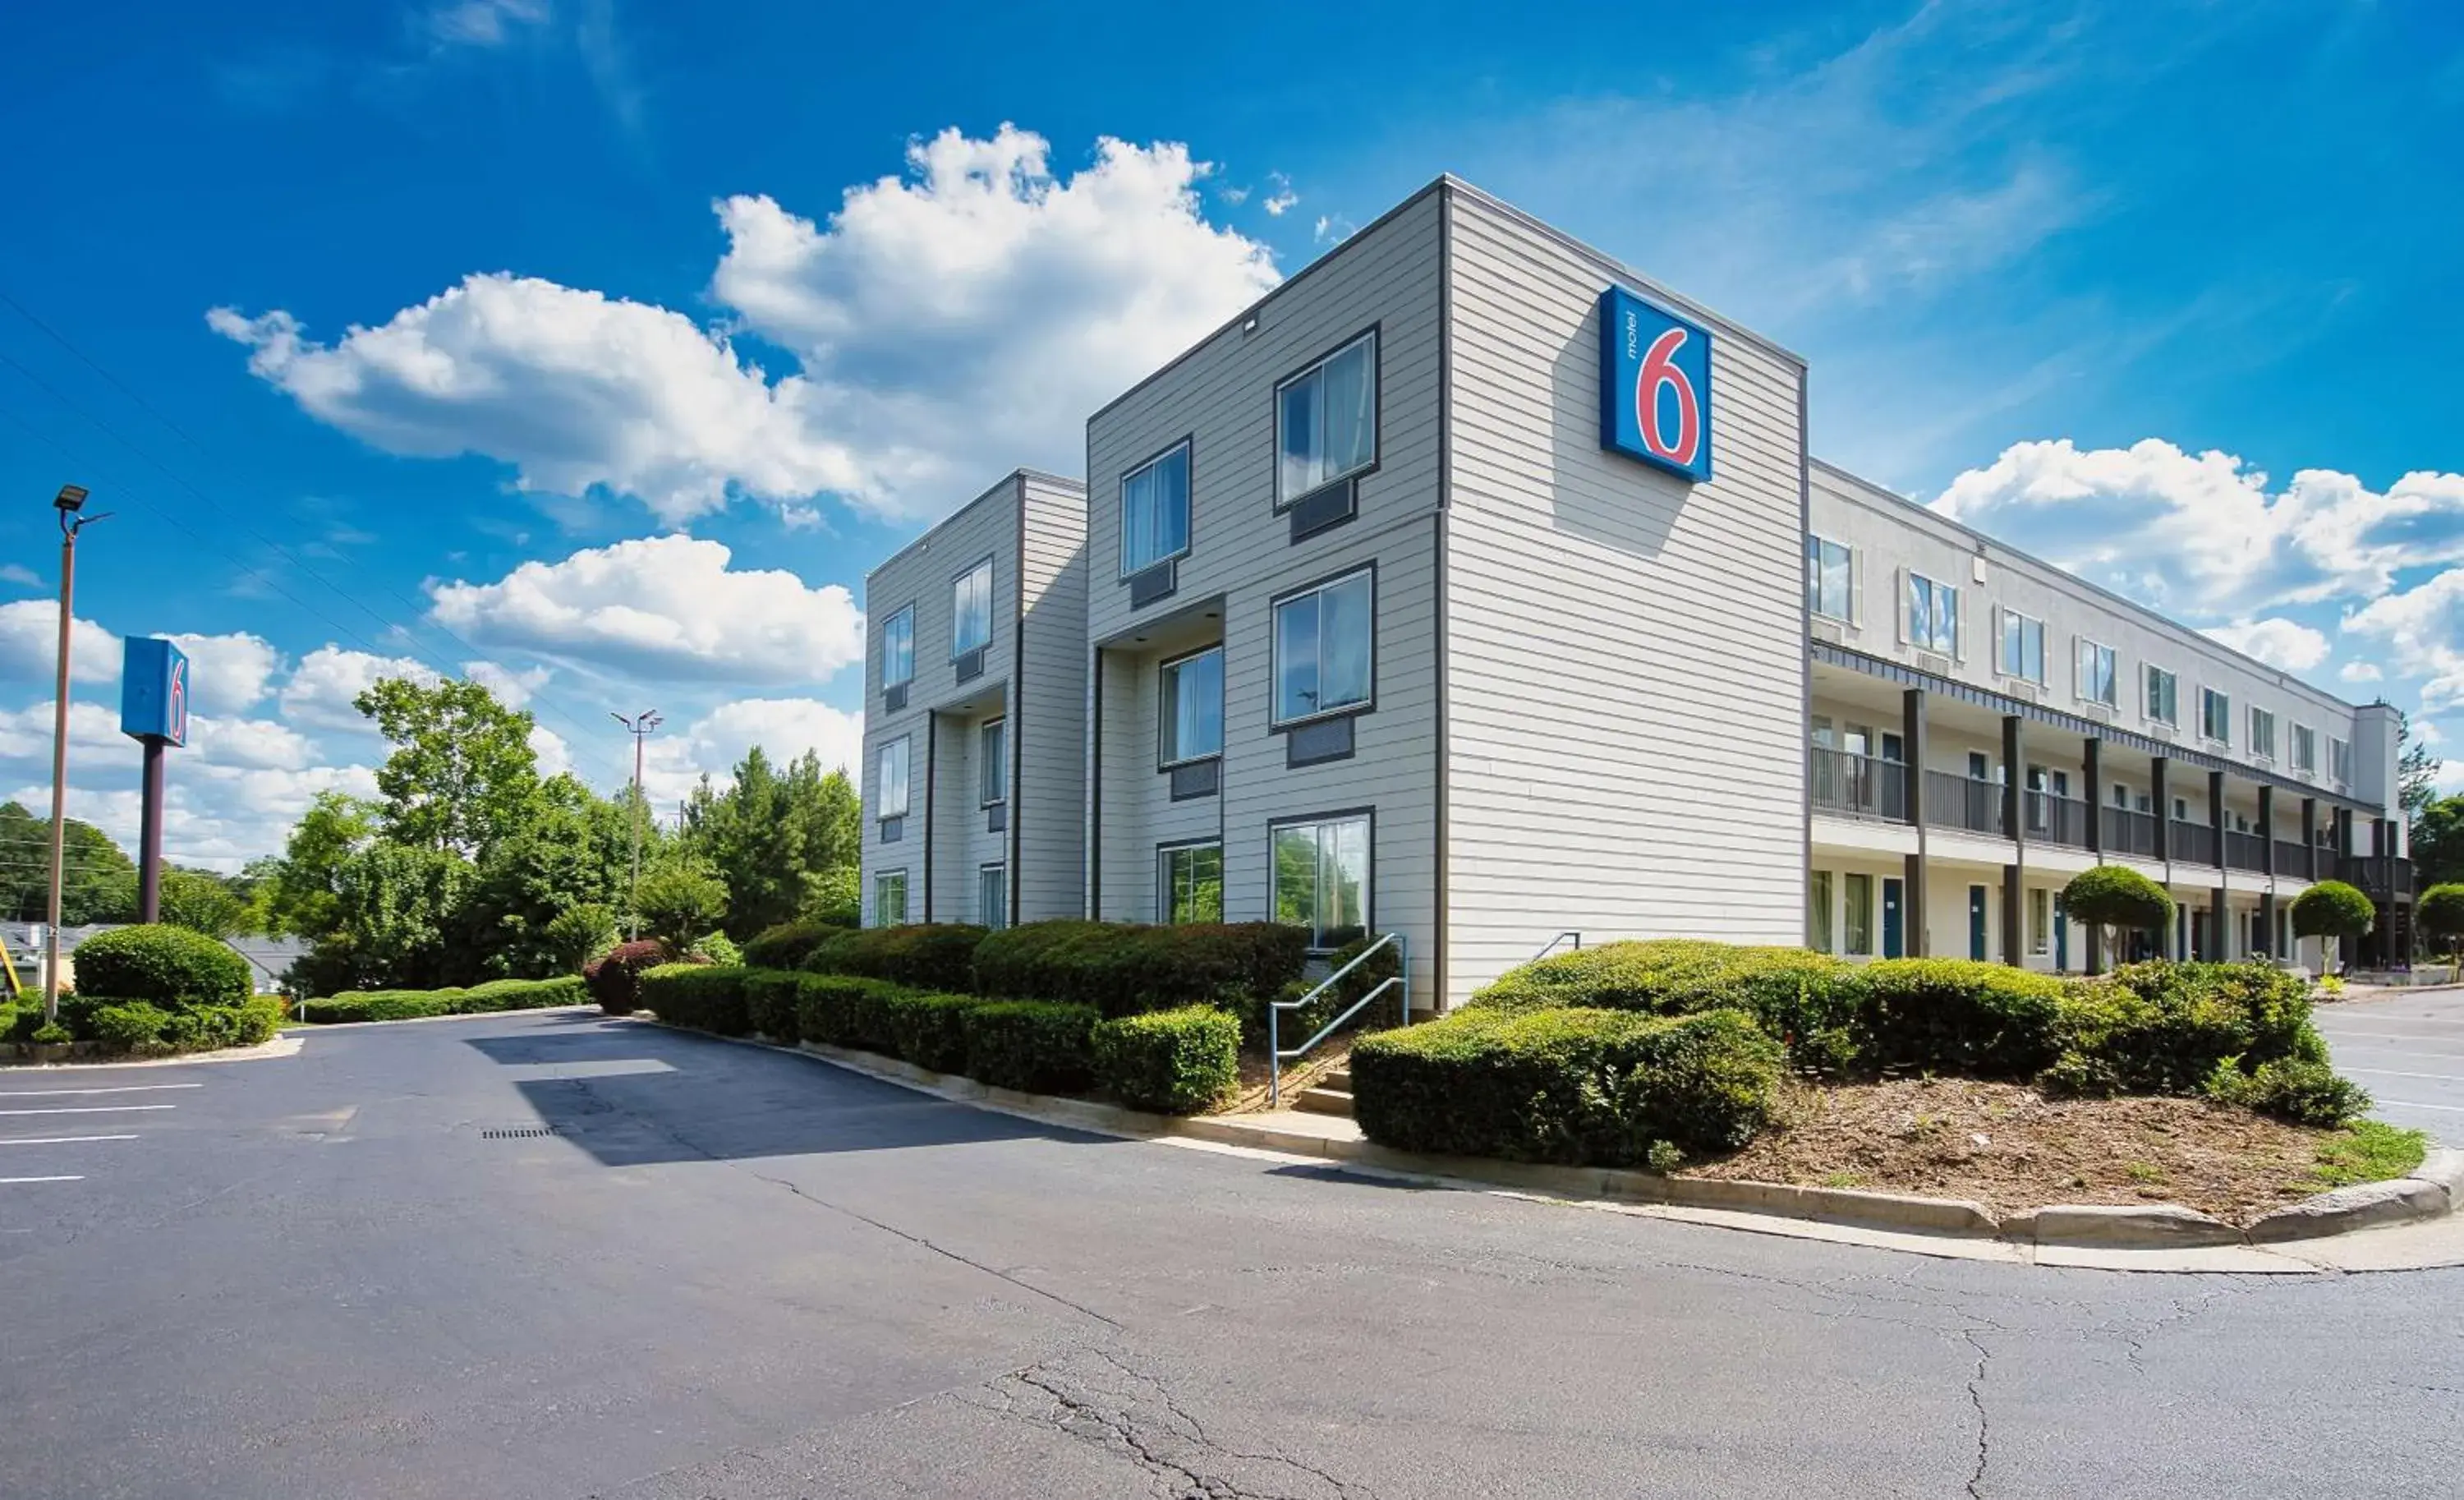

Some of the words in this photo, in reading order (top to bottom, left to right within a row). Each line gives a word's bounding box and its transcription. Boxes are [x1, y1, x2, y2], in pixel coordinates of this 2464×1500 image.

[1626, 310, 1637, 359] motel
[1635, 326, 1699, 466] 6
[169, 658, 185, 743] 6
